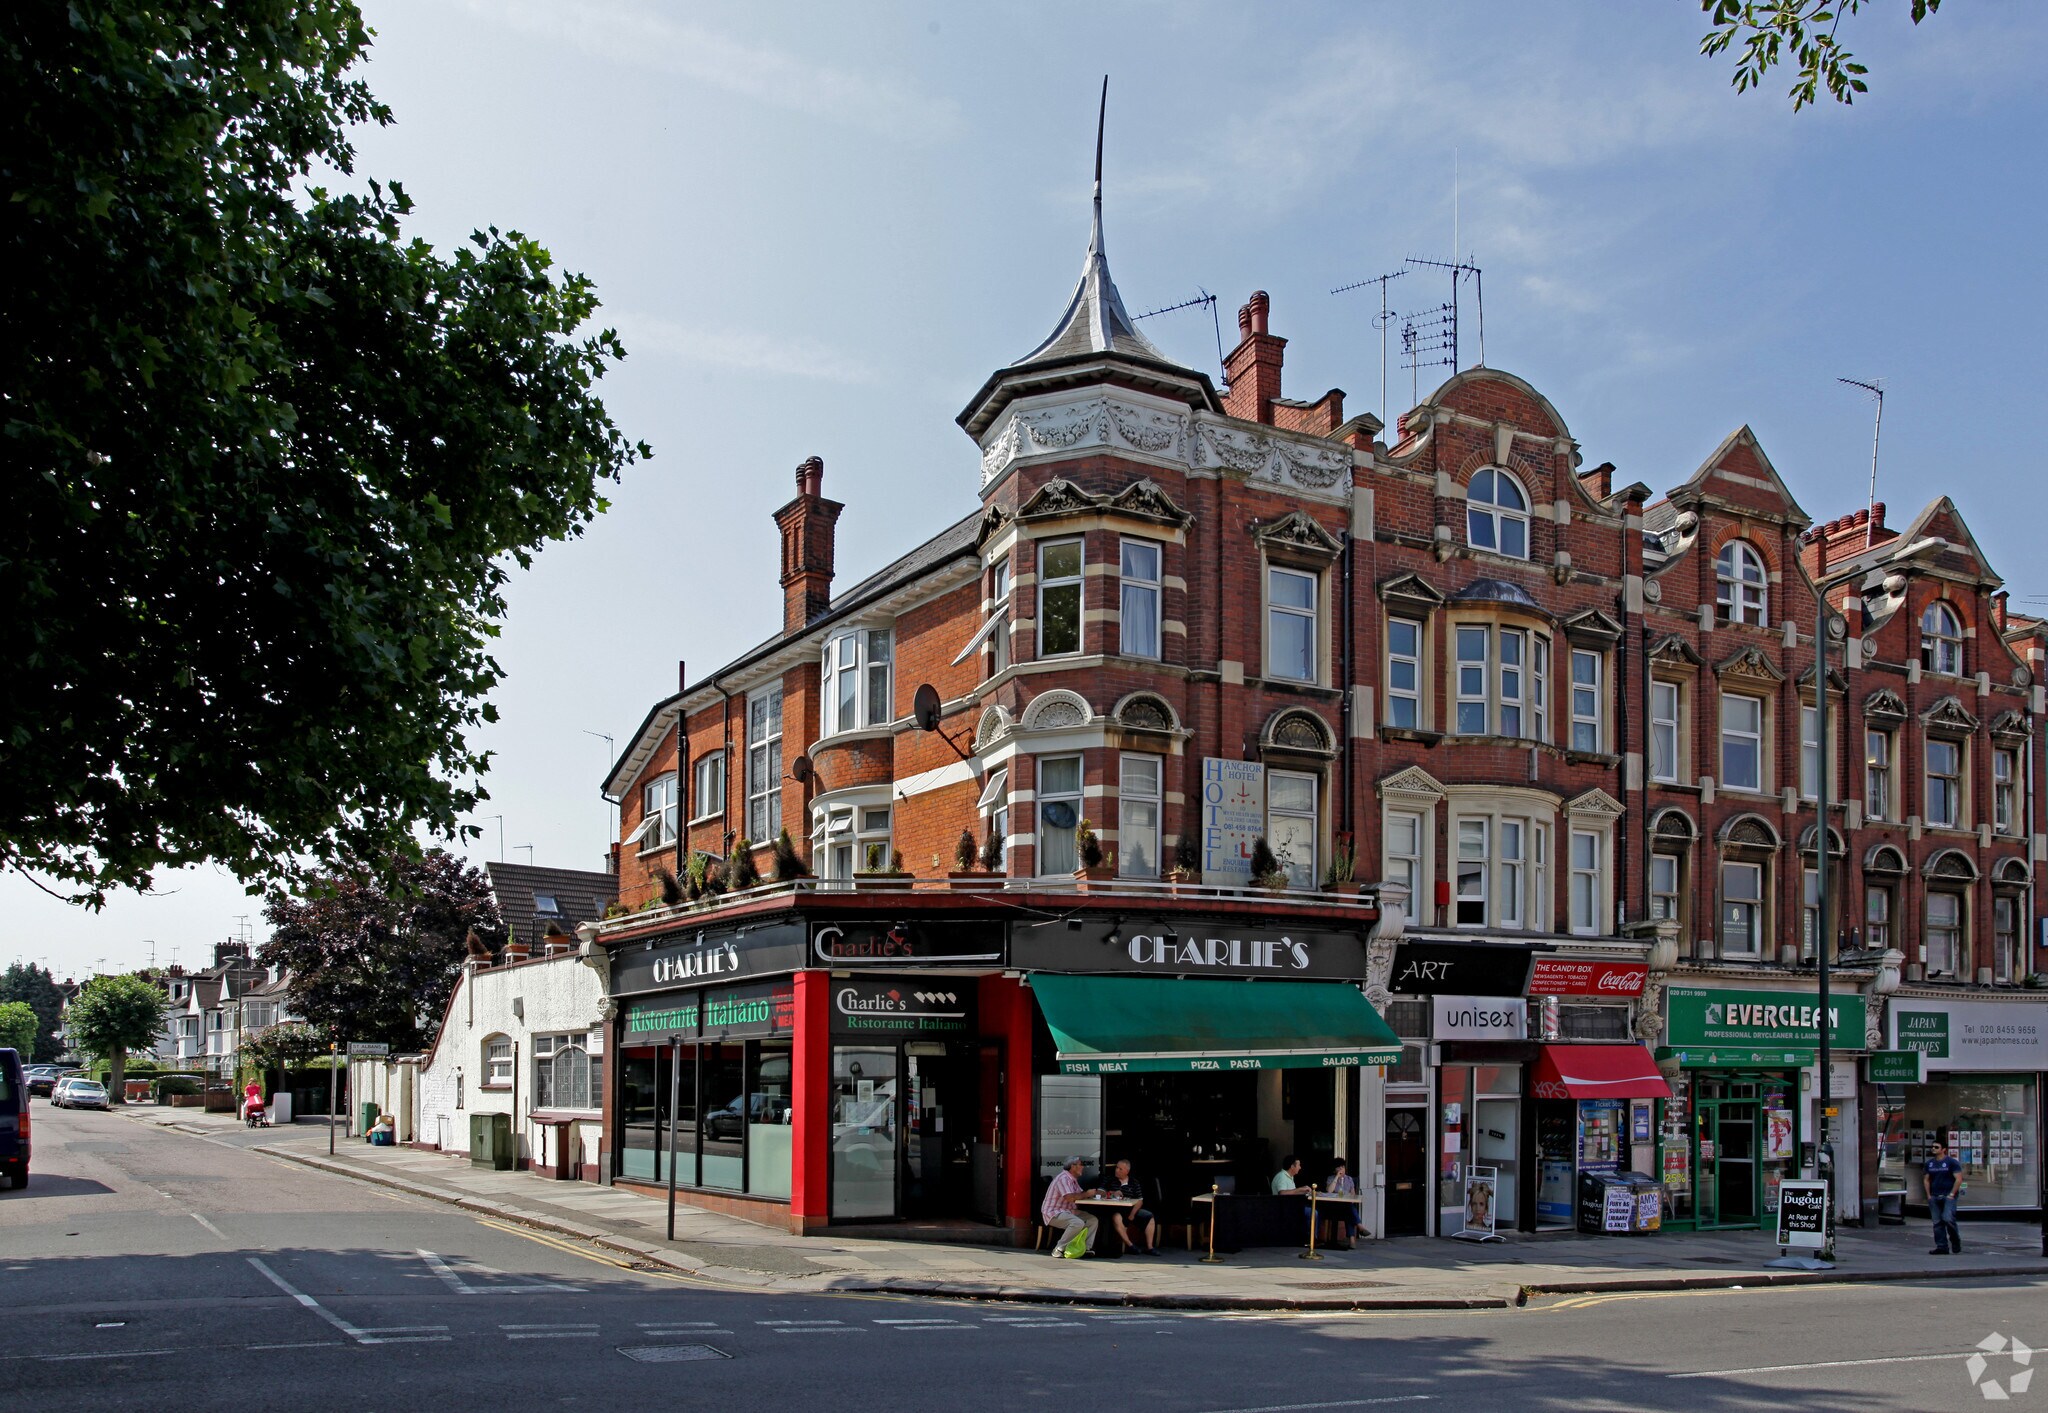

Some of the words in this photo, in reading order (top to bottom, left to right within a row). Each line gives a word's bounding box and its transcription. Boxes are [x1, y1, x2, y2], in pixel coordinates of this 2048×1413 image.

[1224, 761, 1262, 773] ANCHOR
[1228, 771, 1257, 781] HOTEL
[1205, 760, 1223, 872] HOTEL
[1128, 935, 1310, 969] CHARLIE'S
[652, 941, 739, 983] CHARLIE'S
[1399, 961, 1455, 980] ART
[1536, 964, 1551, 972] THE
[1551, 965, 1577, 973] CANDY
[1577, 965, 1593, 973] BOX
[836, 988, 907, 1015] Charlie's
[630, 1005, 698, 1033] Ristorante
[707, 994, 769, 1026] Italiano
[1447, 1007, 1514, 1027] unisex
[1726, 1003, 1839, 1030] EVERCLEAN
[848, 1016, 915, 1029] Ristorante
[918, 1018, 967, 1030] Italiano
[1908, 1017, 1938, 1029] JAPAN
[1704, 1030, 1752, 1039] PROFESSIONAL
[1753, 1032, 1793, 1040] DRYCLEANER
[1964, 1024, 1975, 1034] Tel
[1980, 1025, 1994, 1034] 020
[1996, 1026, 2015, 1034] 8455
[2018, 1026, 2036, 1035] 9656
[1907, 1041, 1941, 1053] HOMES
[1961, 1036, 2039, 1046] www.japanhomes.co.uk
[1066, 1063, 1090, 1072] FISH
[1099, 1063, 1128, 1071] MEAT
[1191, 1061, 1219, 1069] PIZZA
[1230, 1060, 1261, 1068] PASTA
[1323, 1056, 1359, 1066] SALADS
[1368, 1055, 1397, 1064] SOUPS
[1885, 1057, 1903, 1065] DRY
[1874, 1069, 1914, 1077] CLEANER
[1665, 1174, 1686, 1183] 25%
[1640, 1193, 1657, 1204] AMY:
[1784, 1194, 1822, 1206] Dugout
[1800, 1221, 1815, 1229] Shop
